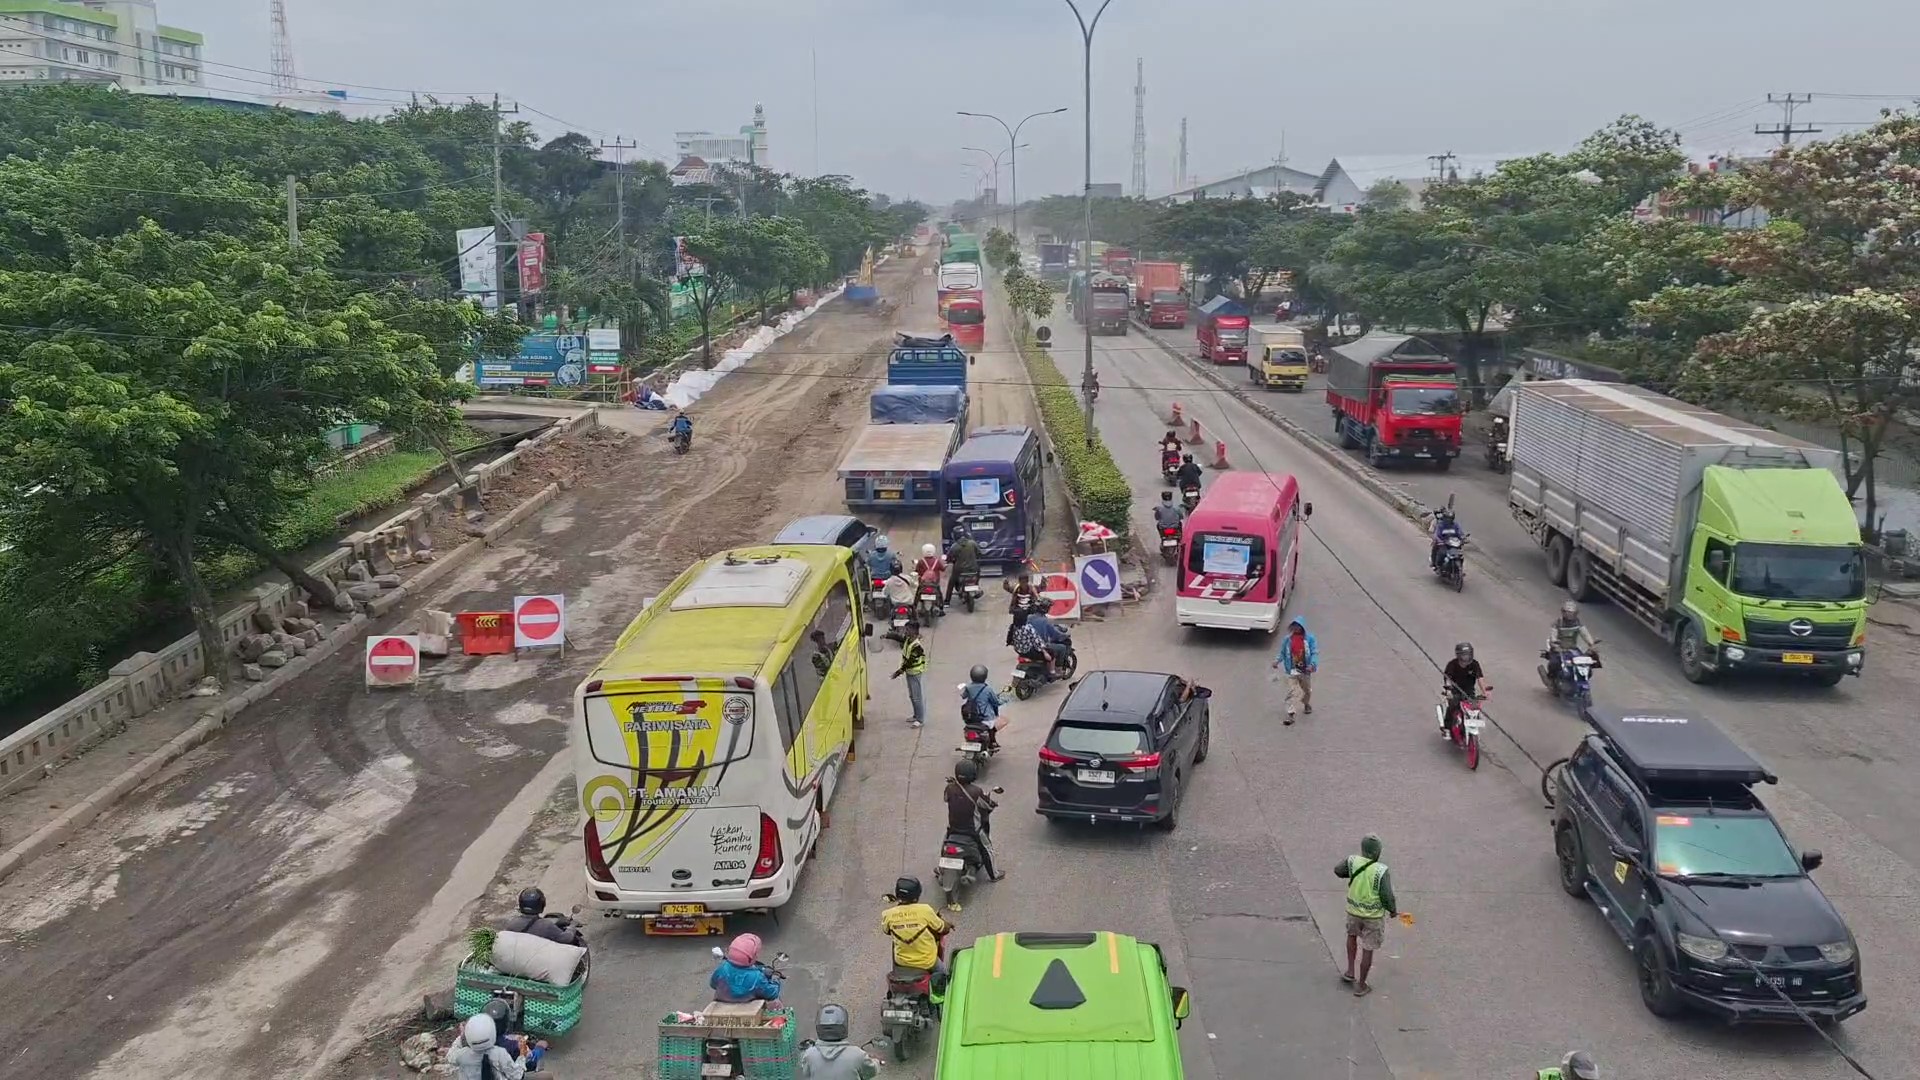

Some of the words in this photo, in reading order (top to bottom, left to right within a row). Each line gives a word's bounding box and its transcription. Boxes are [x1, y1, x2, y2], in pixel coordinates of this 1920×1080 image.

[624, 719, 711, 732] PARIWISATA
[627, 787, 649, 799] PT.
[654, 785, 720, 798] AMANAH
[642, 797, 665, 806] TOUR
[666, 797, 674, 806] &
[674, 795, 709, 805] TRAVEL
[710, 824, 743, 838] Laskar
[713, 832, 752, 846] Bambu
[714, 843, 753, 856] Runcing
[713, 860, 747, 871] AM.04
